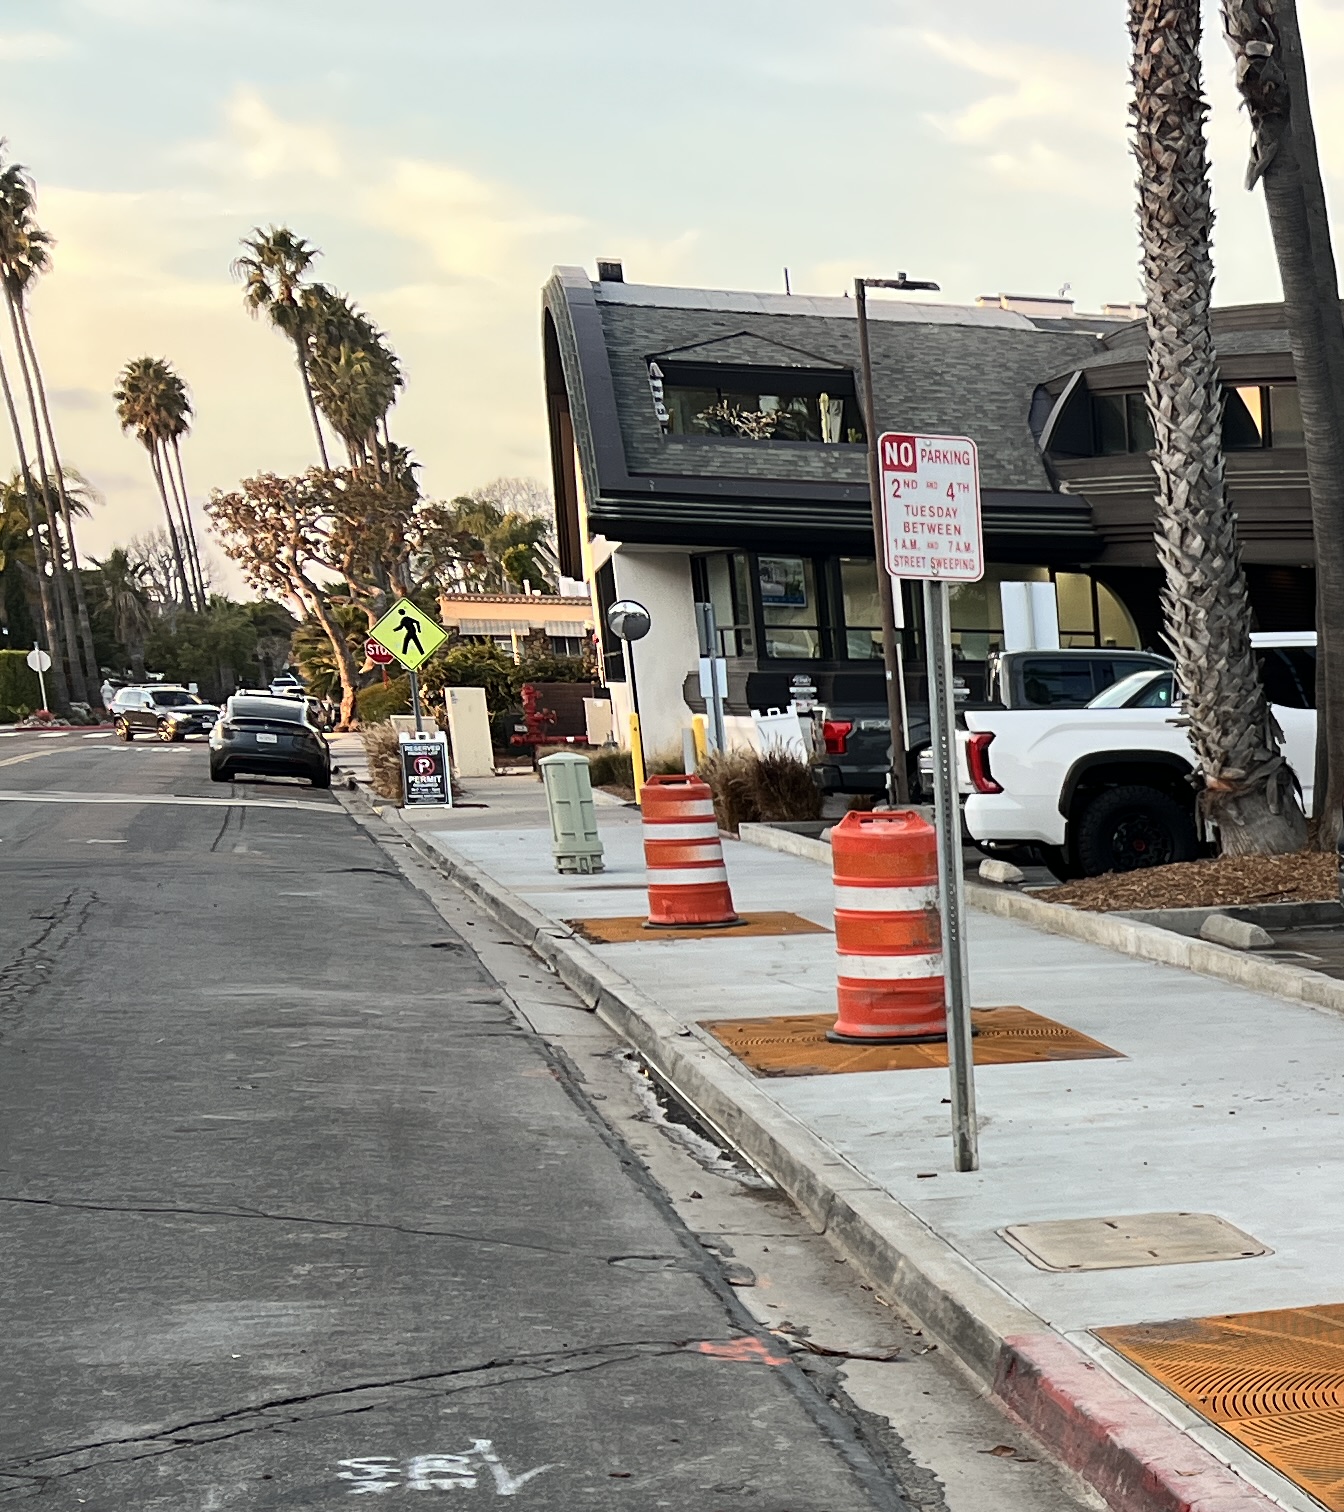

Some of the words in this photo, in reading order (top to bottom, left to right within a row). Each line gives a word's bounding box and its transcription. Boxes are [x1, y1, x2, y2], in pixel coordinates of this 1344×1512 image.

[884, 441, 914, 468] NO
[920, 448, 970, 466] PARKING
[904, 504, 958, 519] TUESDAY
[903, 521, 962, 536] BETWEEN
[893, 554, 926, 569] STREET
[930, 556, 975, 571] SWEEPING
[367, 643, 388, 656] STO
[408, 775, 442, 783] PERMIT
